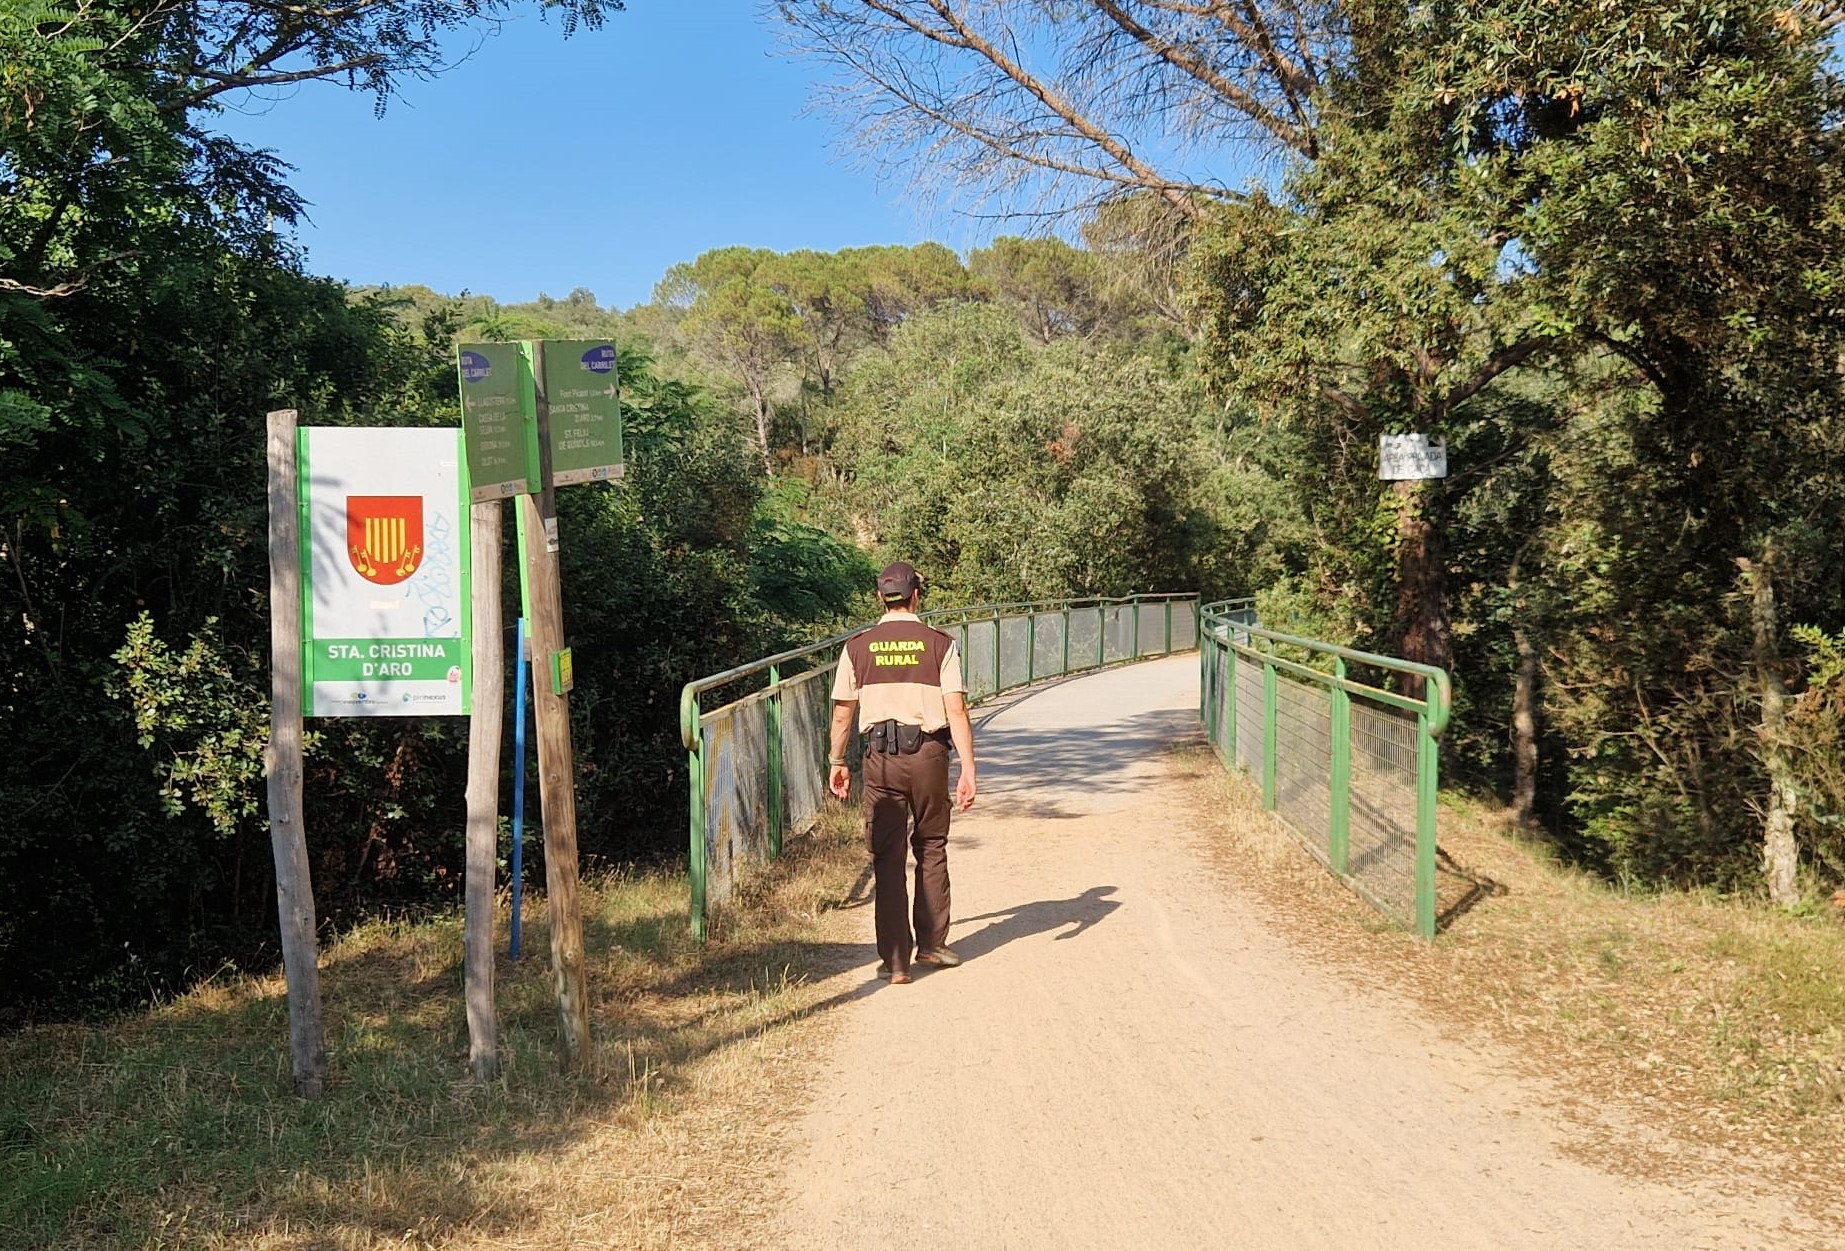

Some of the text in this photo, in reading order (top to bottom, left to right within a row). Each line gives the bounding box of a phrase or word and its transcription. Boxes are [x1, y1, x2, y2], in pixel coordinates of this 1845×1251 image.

[328, 645, 446, 659] STA. CRISTINA
[869, 641, 925, 652] GUARDA
[875, 655, 919, 666] RURAL
[363, 662, 413, 676] D'ARO
